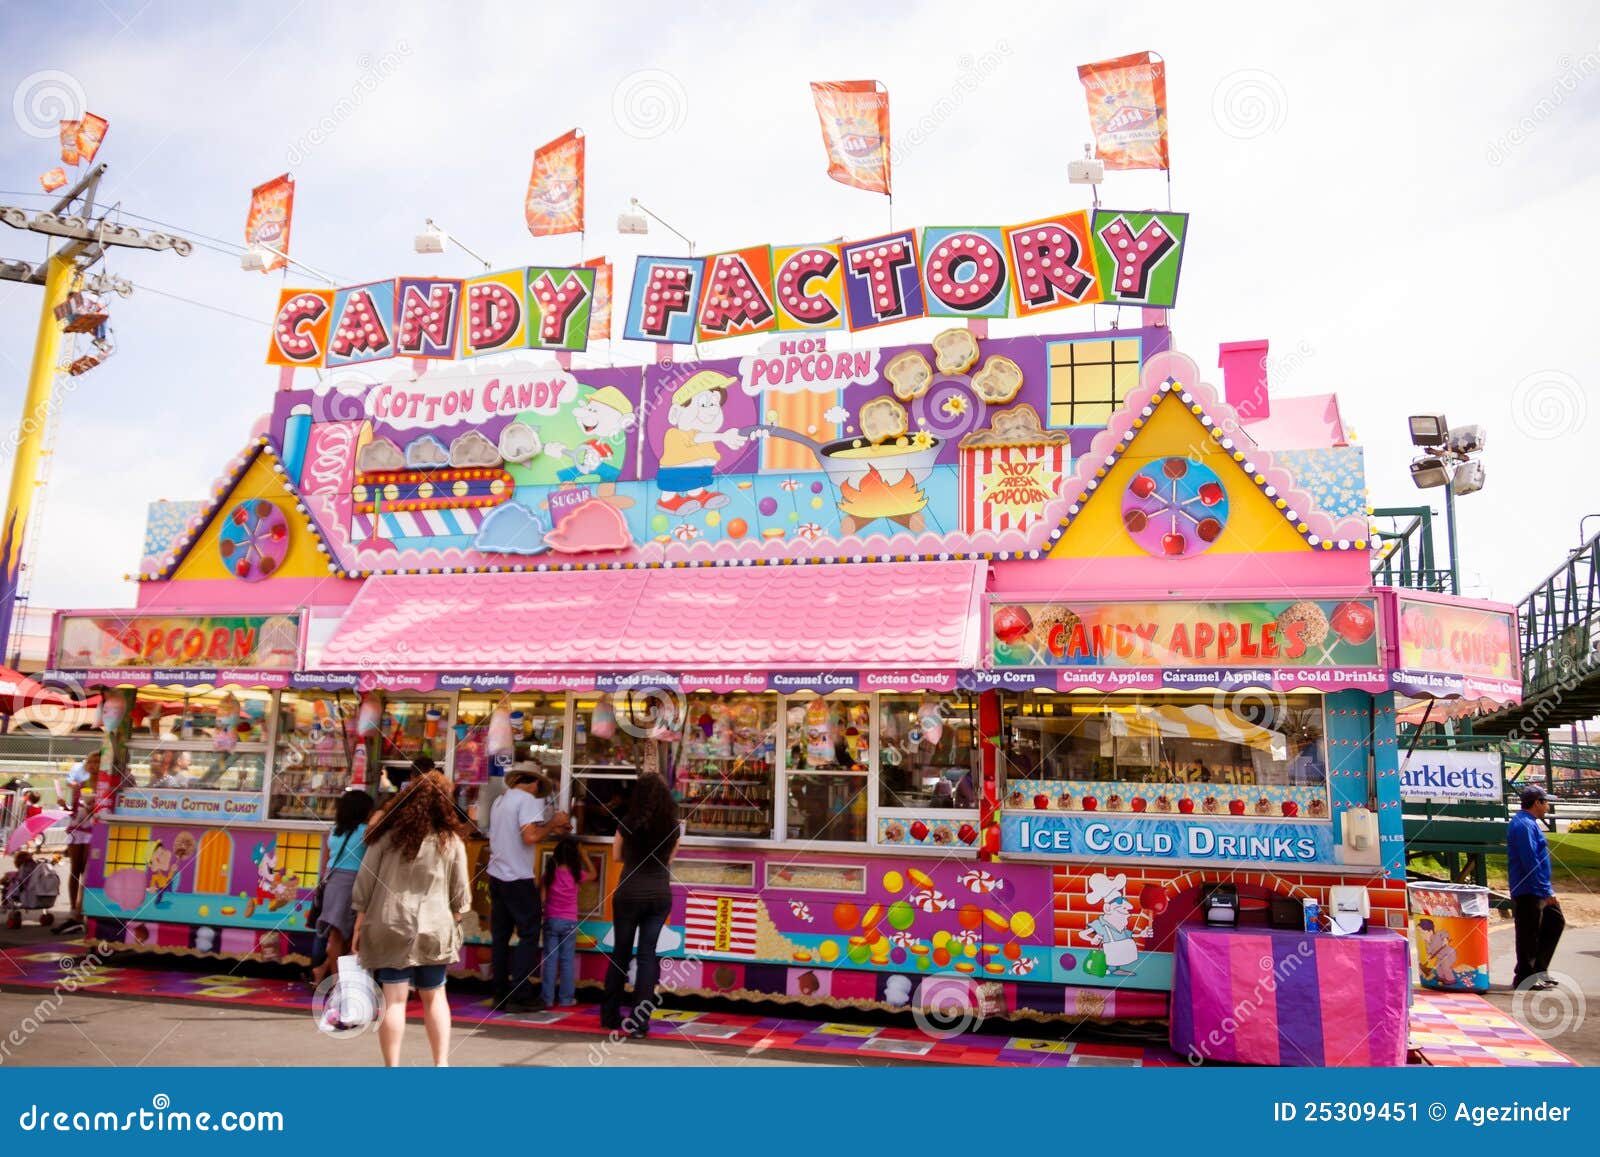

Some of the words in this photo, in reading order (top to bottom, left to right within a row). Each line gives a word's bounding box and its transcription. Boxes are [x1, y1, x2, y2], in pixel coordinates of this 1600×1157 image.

[273, 270, 591, 362] CANDY
[642, 215, 1181, 335] FACTORY
[751, 351, 871, 386] POPCORN
[375, 384, 474, 421] COTTON
[483, 378, 566, 412] CANDY
[998, 477, 1040, 487] FRESH
[999, 462, 1040, 476] HOT
[551, 489, 590, 508] SUGAR
[985, 488, 1049, 505] POPCORN
[102, 627, 256, 659] POPCORN
[1048, 622, 1158, 658] CANDY
[1169, 622, 1307, 658] APPLES
[1451, 630, 1500, 665] CONES
[153, 671, 184, 680] Shaved
[260, 672, 284, 682] Corn
[294, 674, 325, 683] Cotton
[327, 674, 356, 685] Candy
[376, 675, 395, 686] Pop
[396, 675, 421, 684] Corn
[441, 674, 472, 686] Candy
[475, 674, 509, 686] Apples
[514, 674, 557, 685] Caramel
[558, 675, 596, 687] Apples
[597, 674, 613, 685] Ice
[614, 674, 640, 685] Cold
[642, 673, 680, 685] Drinks
[682, 674, 722, 685] Shaved
[724, 674, 742, 685] Ice
[743, 674, 765, 685] Sno
[774, 674, 822, 685] Caramel
[824, 674, 853, 685] Corn
[867, 674, 908, 685] Cotton
[910, 674, 949, 687] Candy
[976, 672, 1001, 684] Pop
[1003, 672, 1036, 682] Corn
[1063, 671, 1104, 684] Candy
[1107, 671, 1154, 685] Apples
[1163, 671, 1220, 682] Caramel
[1223, 671, 1271, 685] Apples
[1274, 670, 1294, 682] Ice
[1297, 670, 1330, 682] Cold
[1334, 670, 1385, 682] Drinks
[1392, 671, 1428, 683] Shaved
[1430, 675, 1443, 686] Ice
[117, 795, 147, 808] FRESH
[151, 796, 177, 810] SPUN
[181, 797, 220, 812] COTTON
[224, 799, 258, 814] CANDY
[1020, 819, 1070, 851] ICE
[1084, 822, 1173, 854] COLD
[1188, 826, 1316, 859] DRINKS
[718, 898, 731, 950] POPCORN
